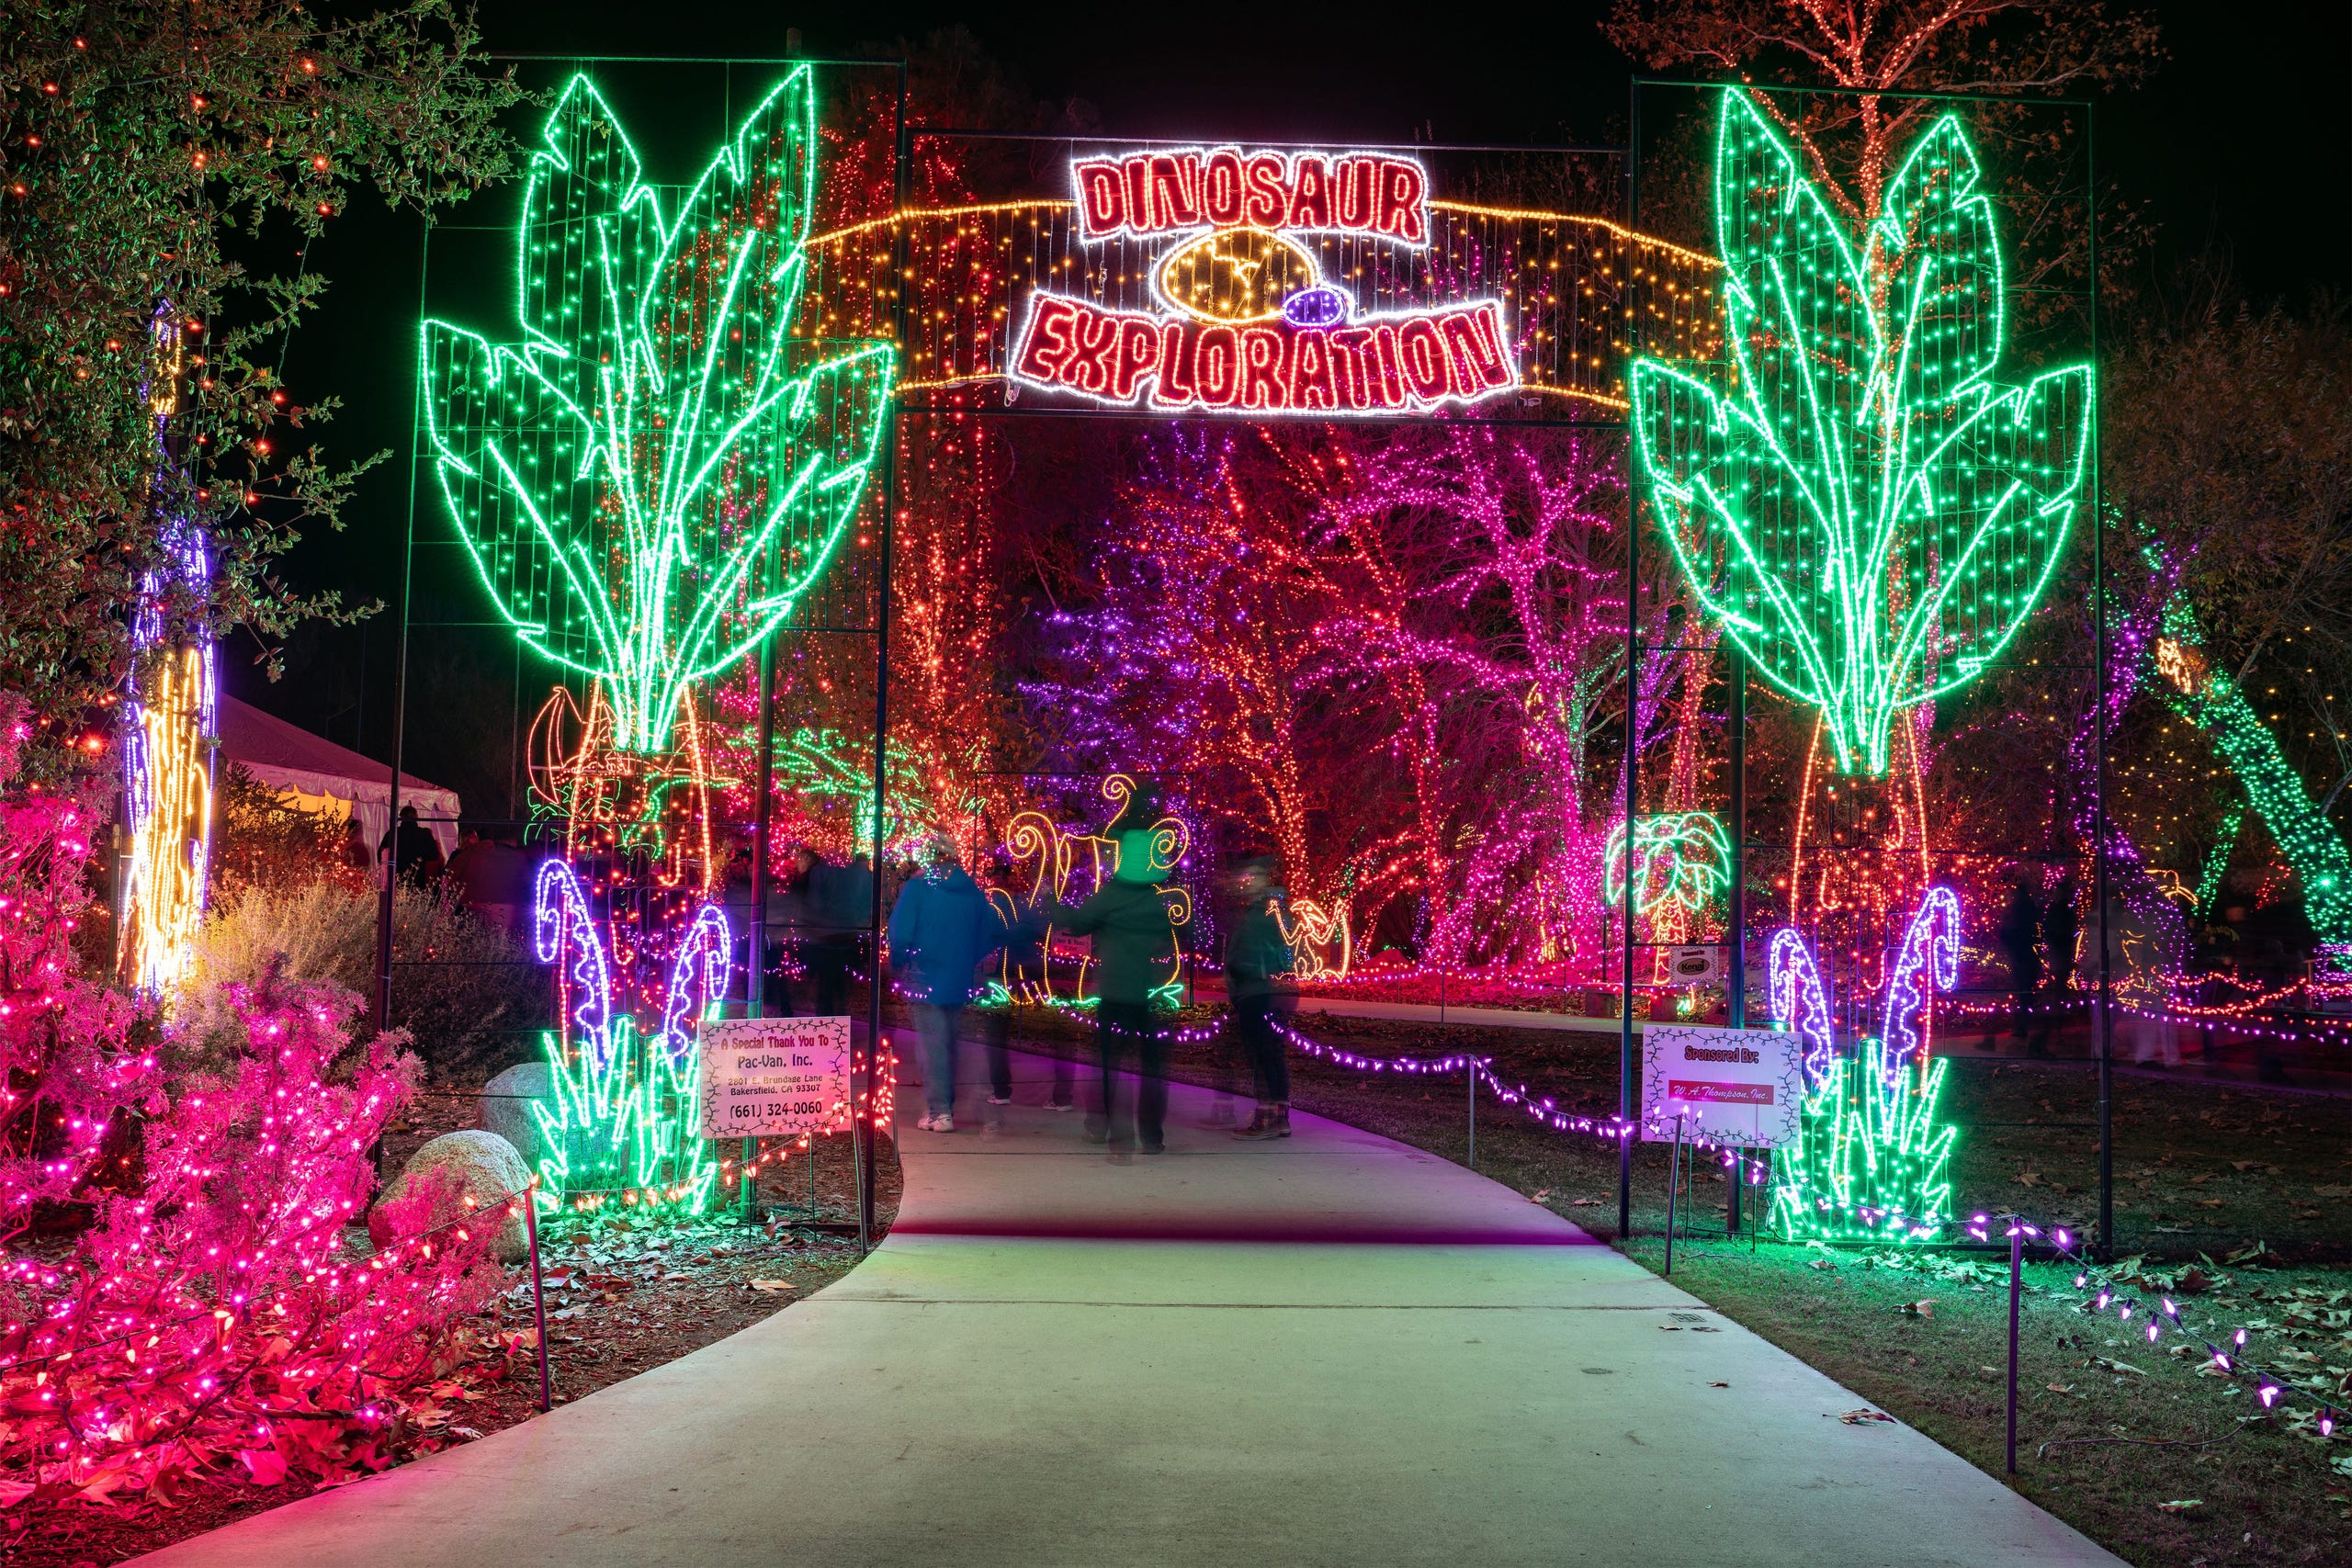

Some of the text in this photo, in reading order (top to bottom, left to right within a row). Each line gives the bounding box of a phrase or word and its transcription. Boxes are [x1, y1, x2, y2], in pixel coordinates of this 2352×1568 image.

[1074, 149, 1428, 244] DINOSAUR
[1017, 296, 1516, 412] EXPLORATION
[721, 1034, 830, 1050] A Special Thank You To
[738, 1054, 813, 1068] Pac-Van, Inc.
[1684, 1045, 1759, 1064] Sponsored By:
[728, 1077, 747, 1086] 2801
[752, 1077, 760, 1085] E.
[763, 1076, 801, 1084] Brundage
[797, 1084, 820, 1092] 93307
[1750, 1089, 1769, 1100] Inc.
[730, 1101, 822, 1119] (661) 324-0060
